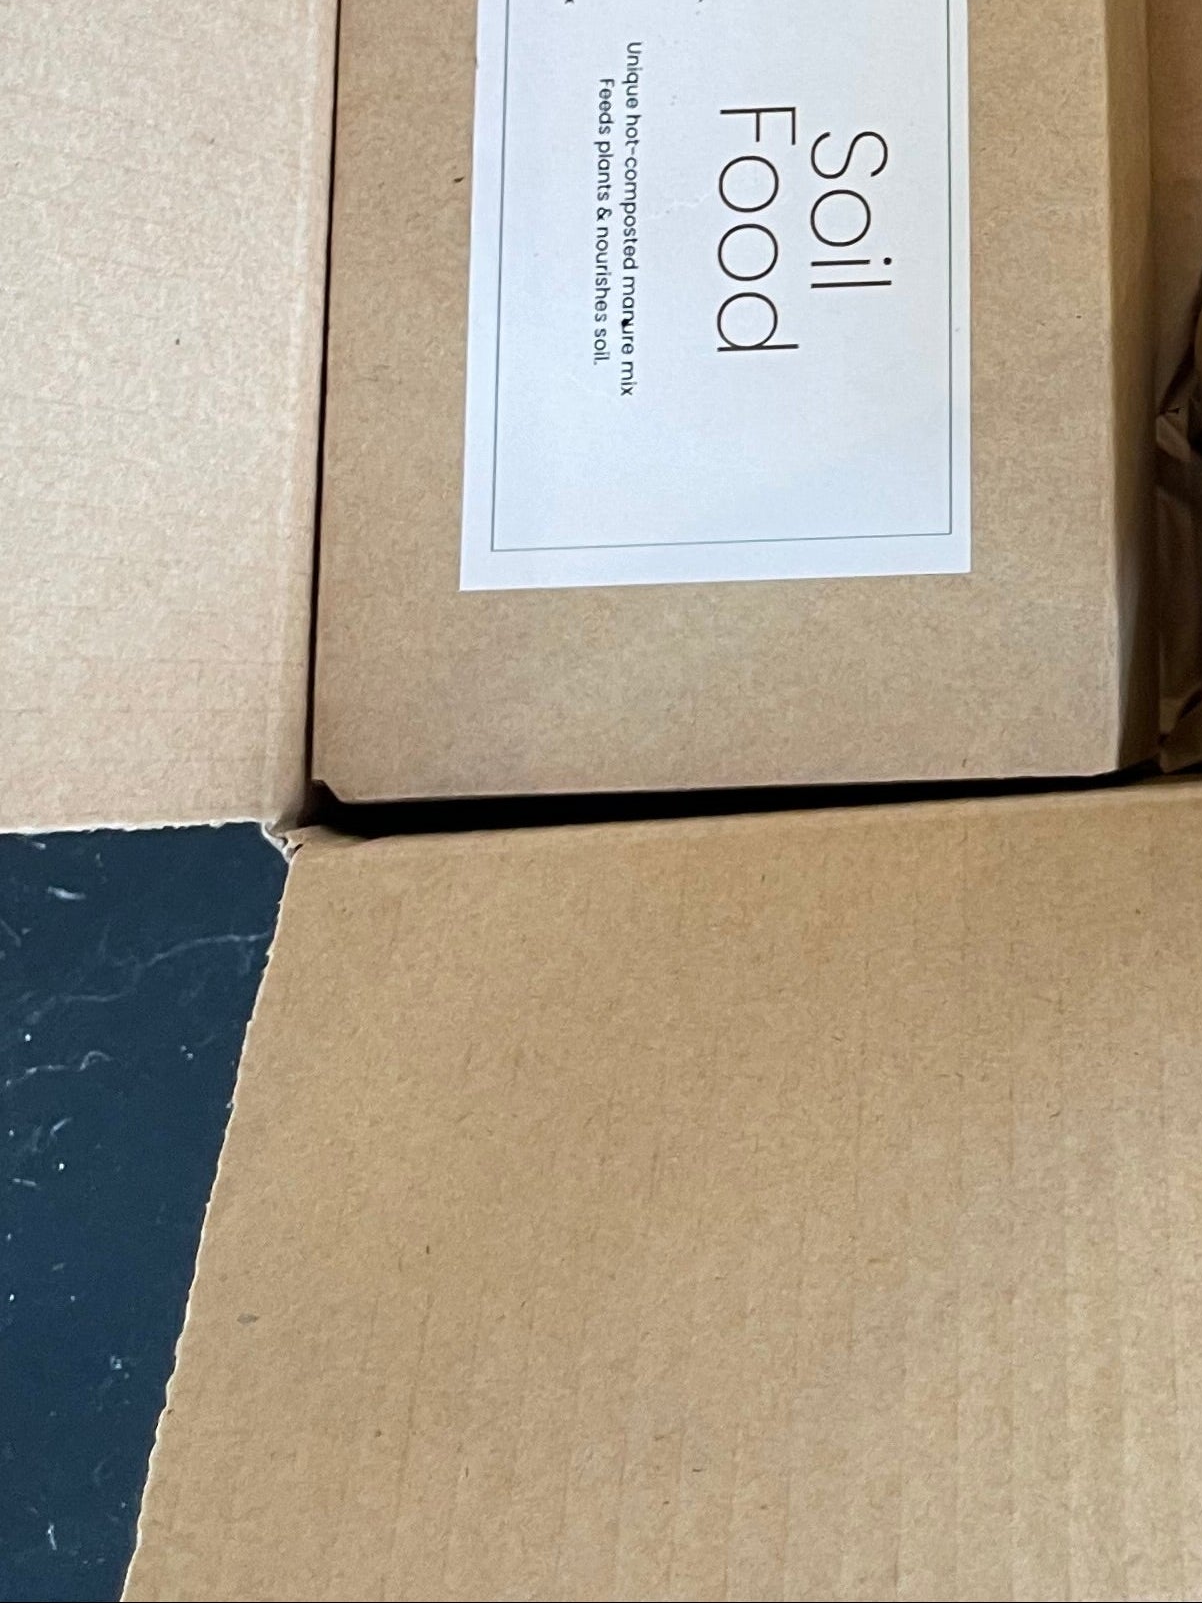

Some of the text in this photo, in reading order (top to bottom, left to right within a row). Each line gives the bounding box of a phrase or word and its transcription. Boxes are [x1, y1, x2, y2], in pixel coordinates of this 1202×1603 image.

[593, 78, 615, 366] Feeds plants & nourishes soil.
[618, 41, 643, 397] Unique hot-composted manure mix
[717, 106, 799, 353] Food
[810, 131, 892, 289] Soil
